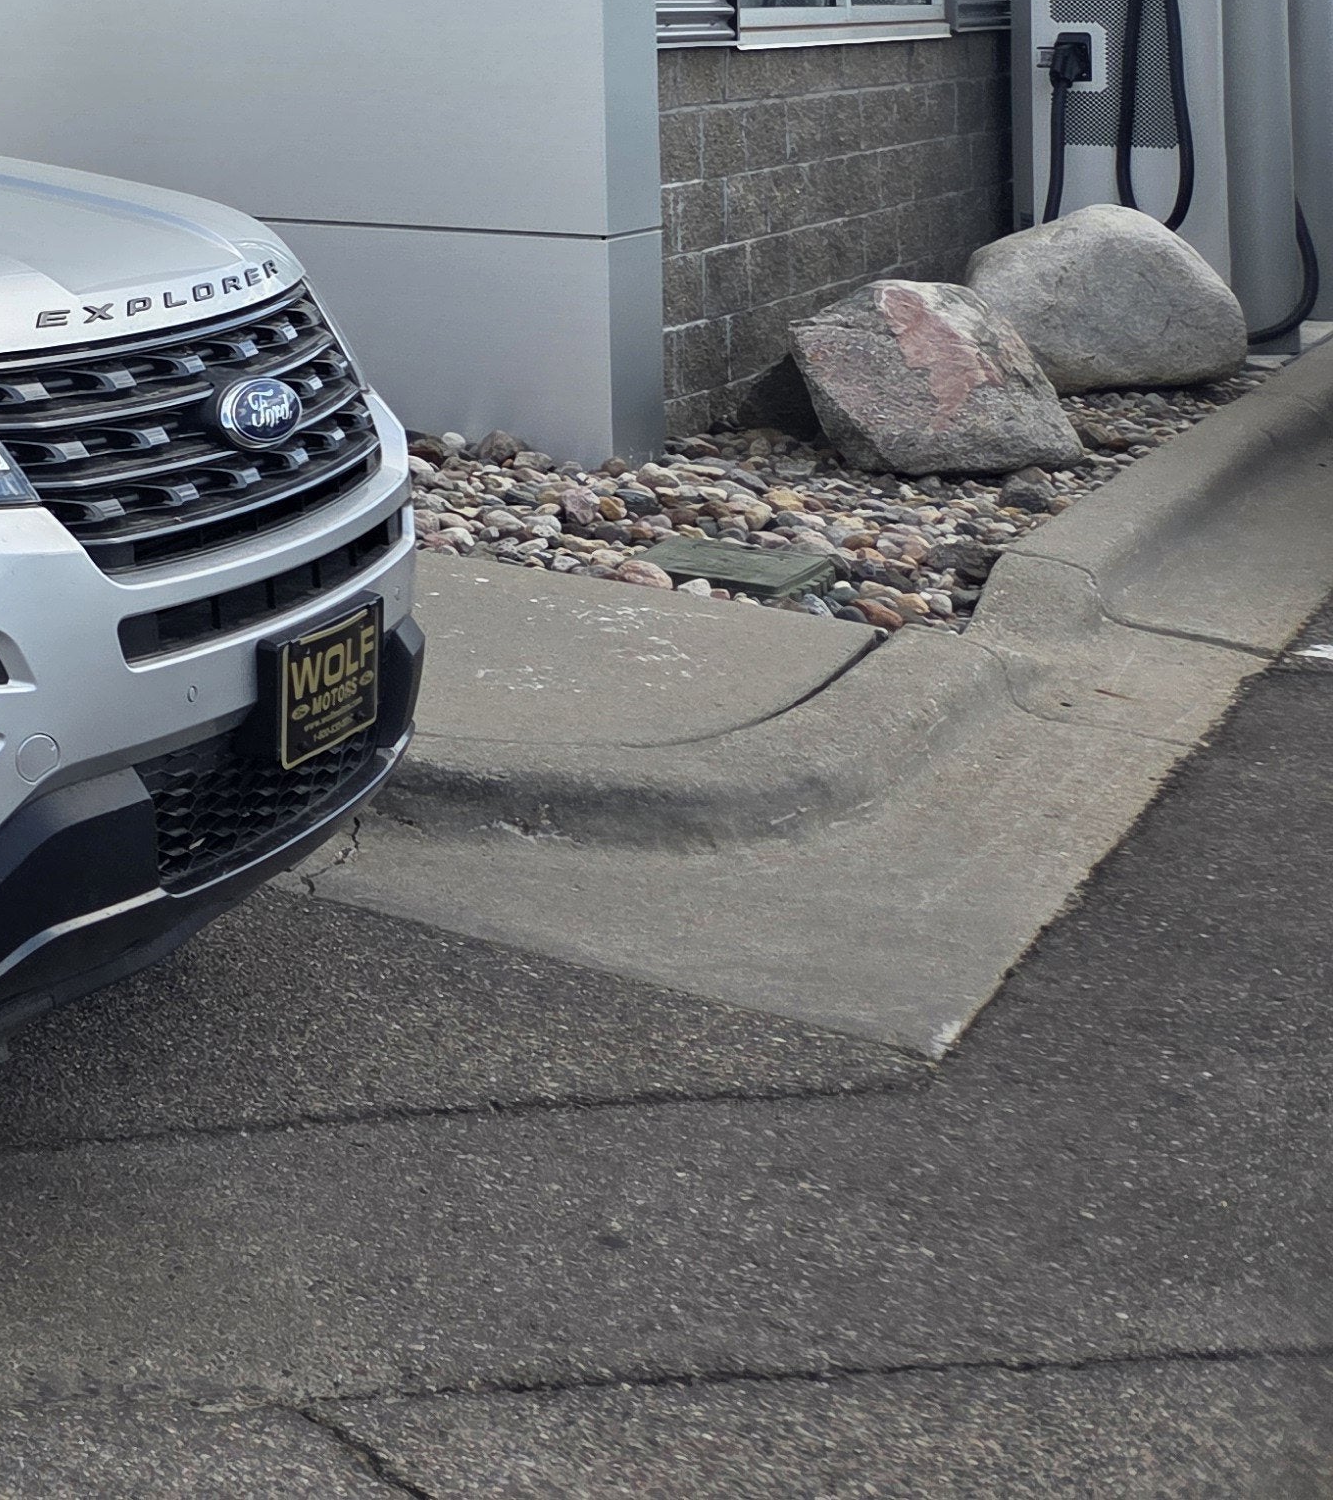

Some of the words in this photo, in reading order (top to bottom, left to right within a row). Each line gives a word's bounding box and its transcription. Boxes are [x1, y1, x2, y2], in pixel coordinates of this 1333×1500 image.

[36, 259, 279, 328] EXPLORER
[247, 388, 293, 428] Ford
[291, 625, 375, 700] WOLF
